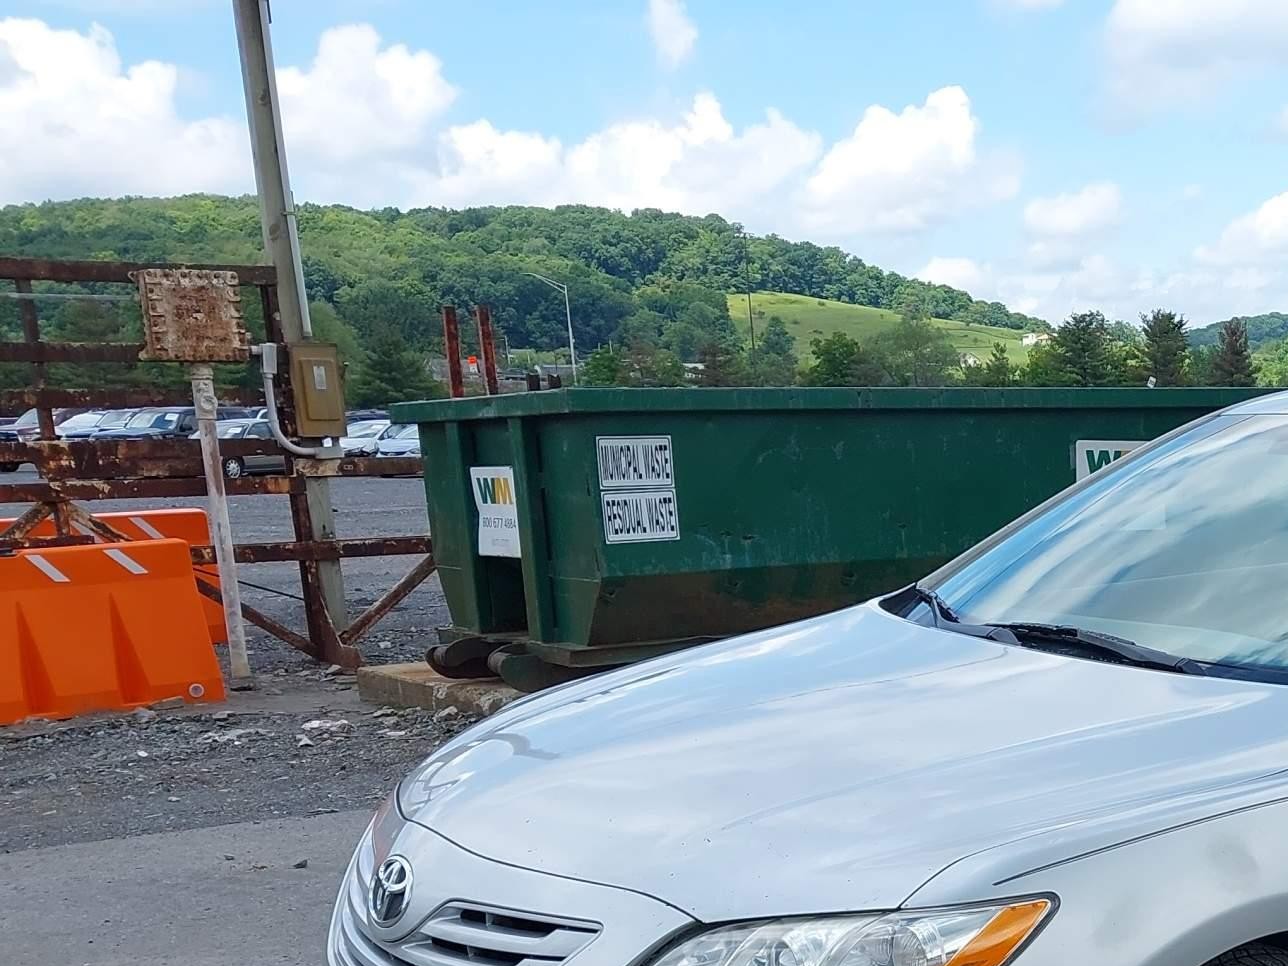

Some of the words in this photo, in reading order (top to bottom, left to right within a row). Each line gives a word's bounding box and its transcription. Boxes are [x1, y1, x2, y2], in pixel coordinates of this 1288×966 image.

[600, 445, 642, 480] MUNICIPAL
[642, 444, 670, 479] WASTE
[1085, 450, 1131, 474] W
[475, 477, 513, 505] WM
[493, 517, 503, 529] 677
[605, 498, 647, 535] RESIDUAL
[645, 497, 675, 533] WASTE
